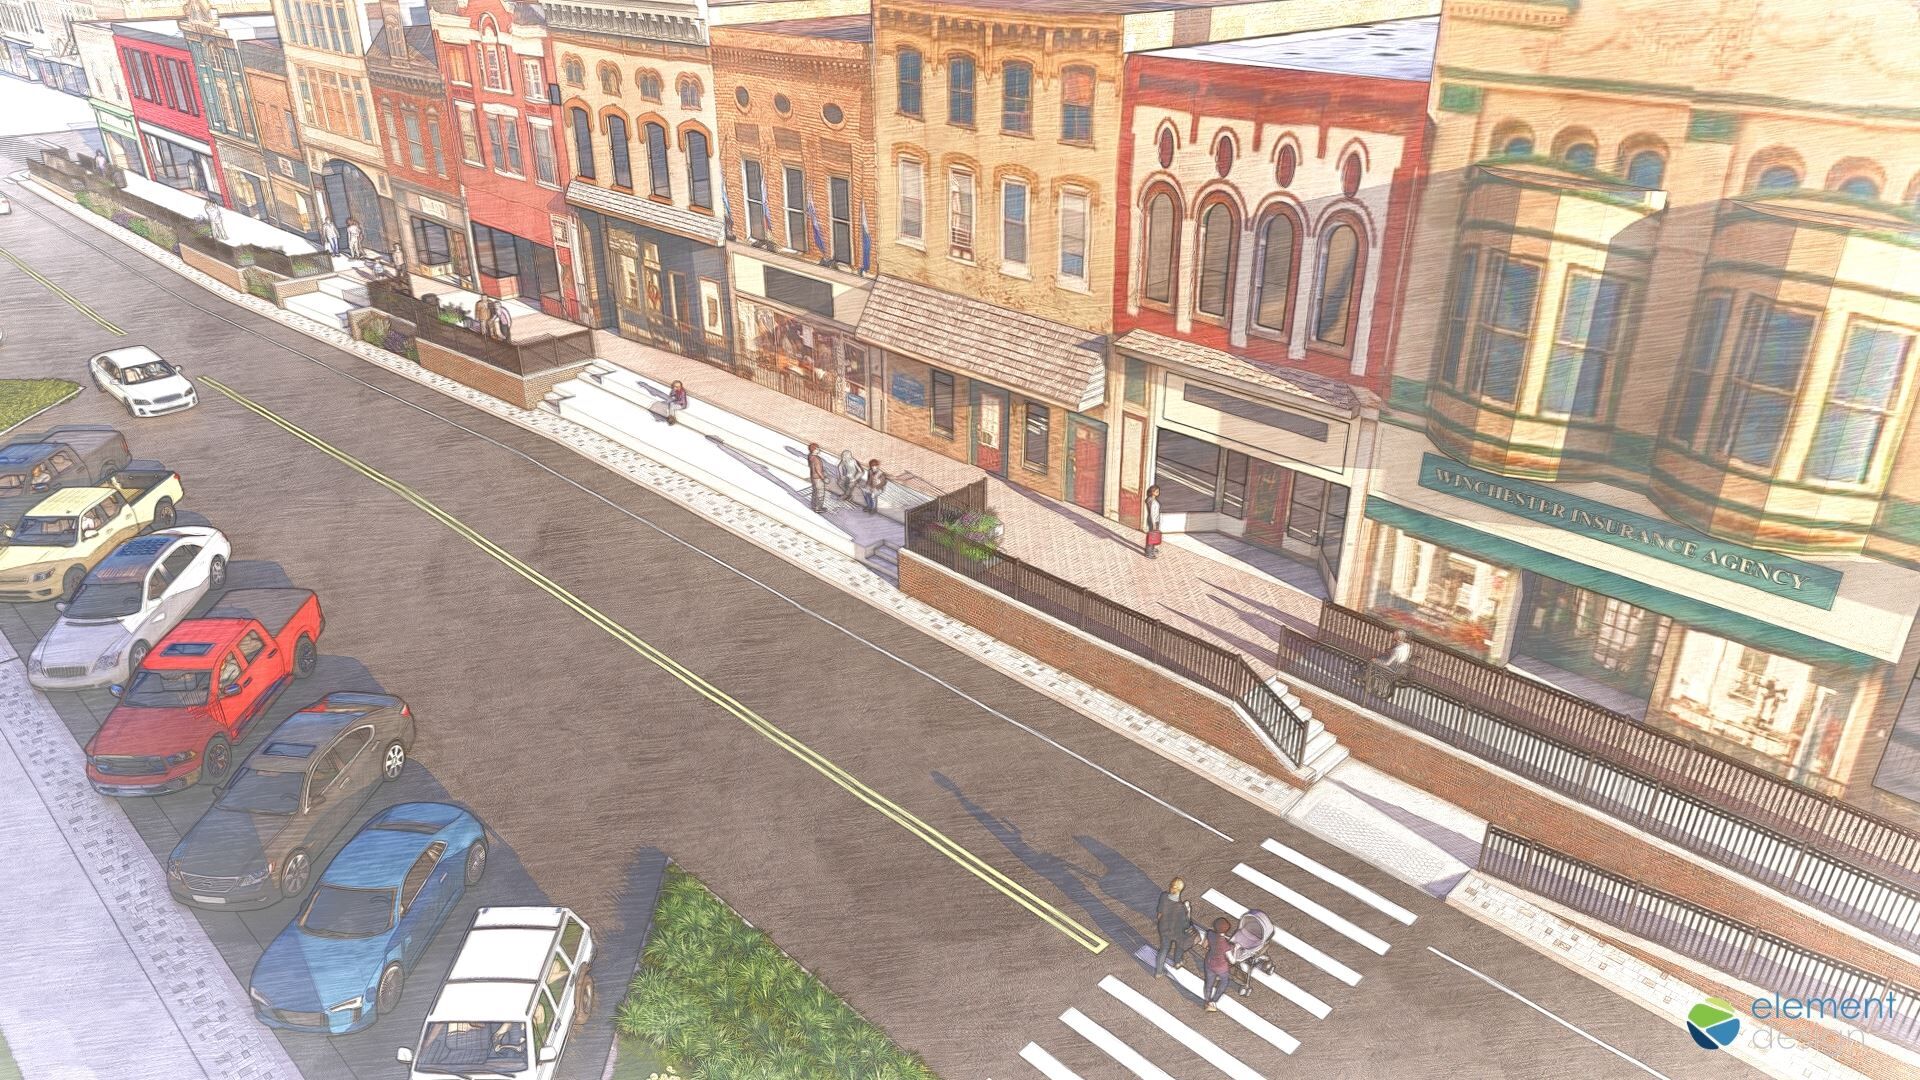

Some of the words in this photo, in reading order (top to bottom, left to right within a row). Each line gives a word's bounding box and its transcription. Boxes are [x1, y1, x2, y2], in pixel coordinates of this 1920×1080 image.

[1435, 467, 1566, 518] WINCHESTER
[1570, 508, 1698, 559] INSURANCE
[1703, 548, 1810, 590] AGENCY
